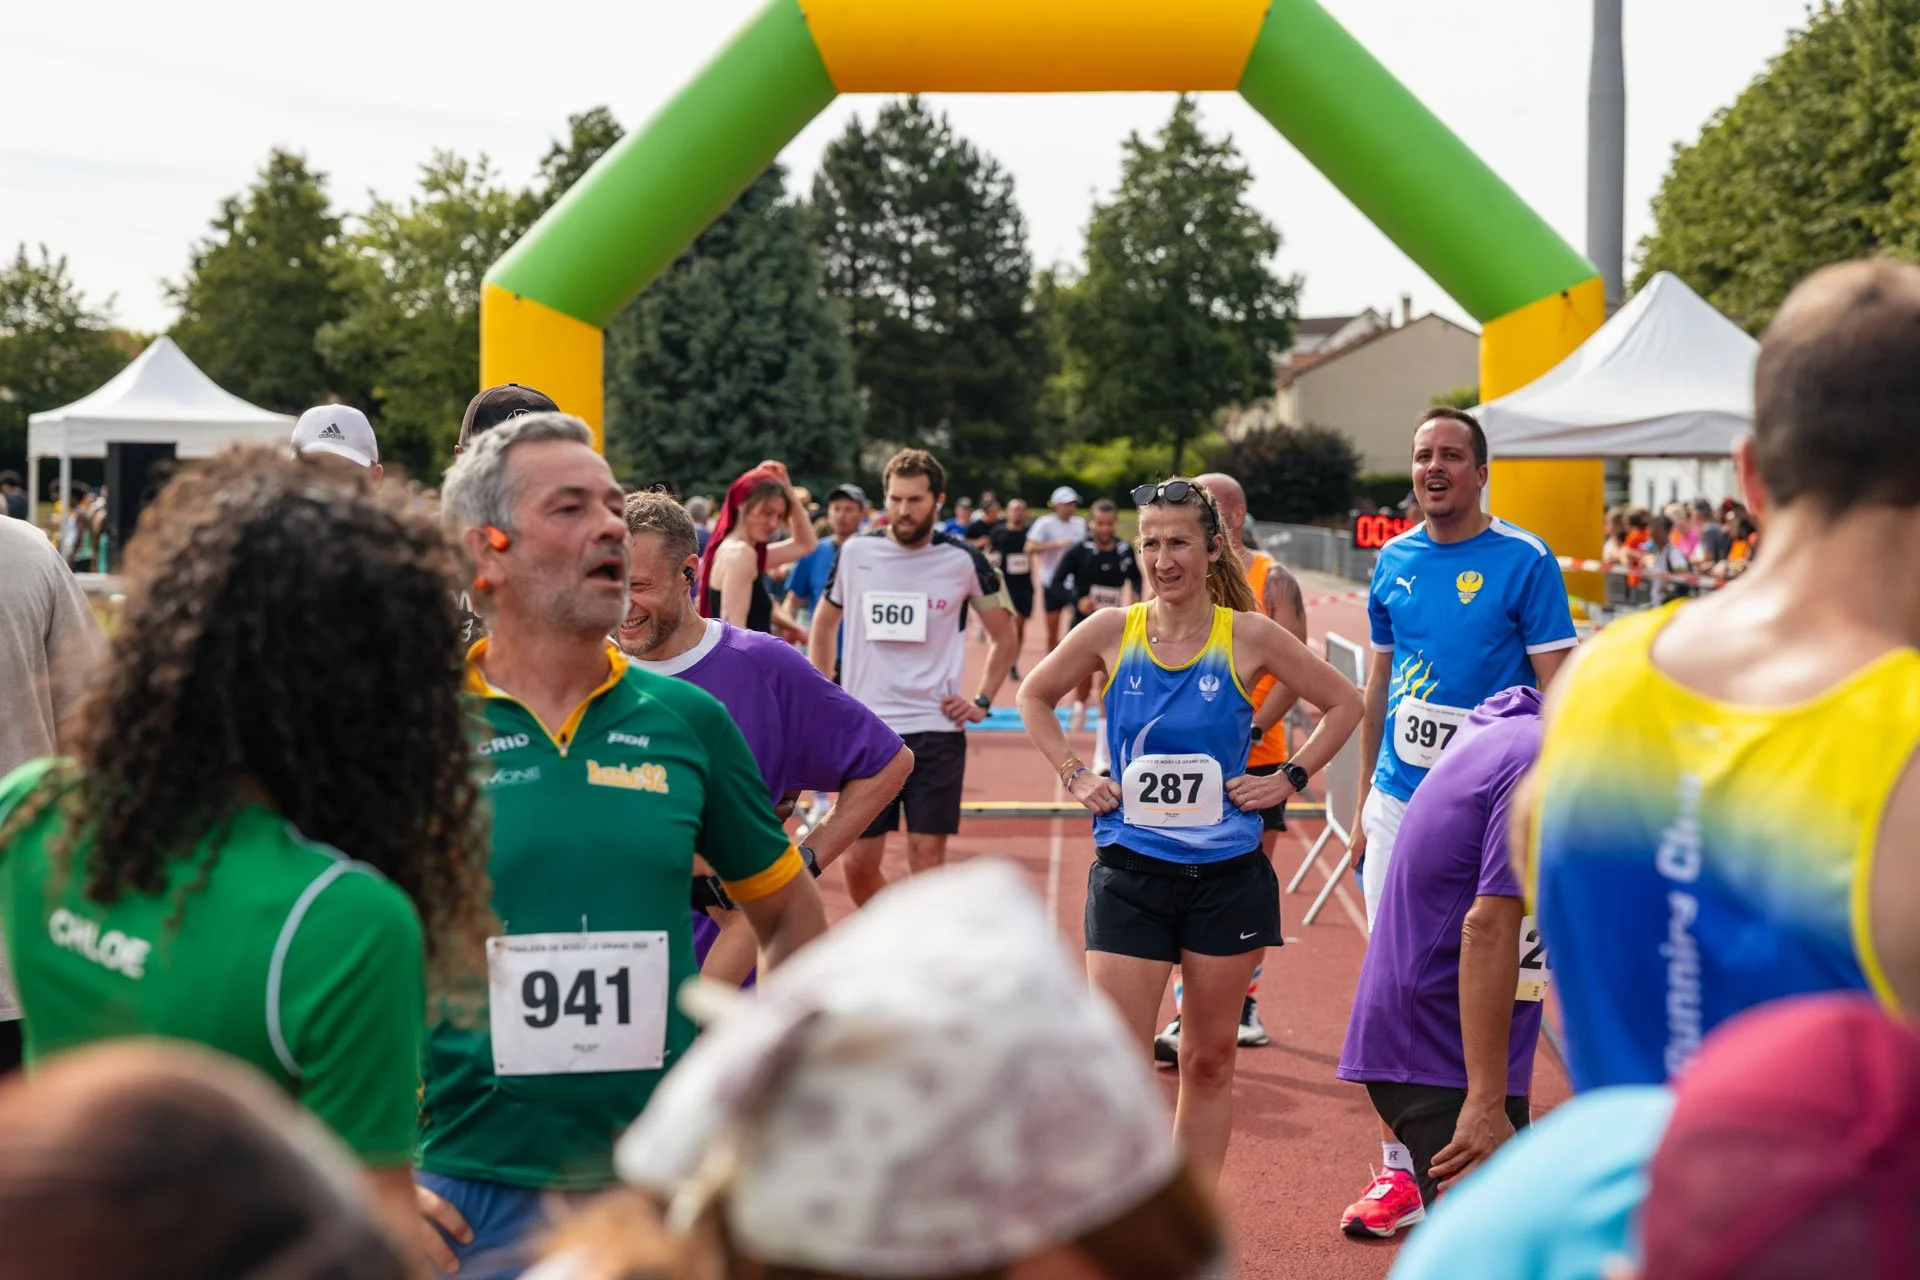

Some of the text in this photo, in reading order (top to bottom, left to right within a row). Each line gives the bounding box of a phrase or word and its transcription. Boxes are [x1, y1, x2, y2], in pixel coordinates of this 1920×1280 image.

[318, 431, 346, 441] adidas
[871, 603, 915, 626] 560
[1405, 715, 1457, 750] 397
[1138, 771, 1204, 804] 287
[521, 966, 631, 1029] 941
